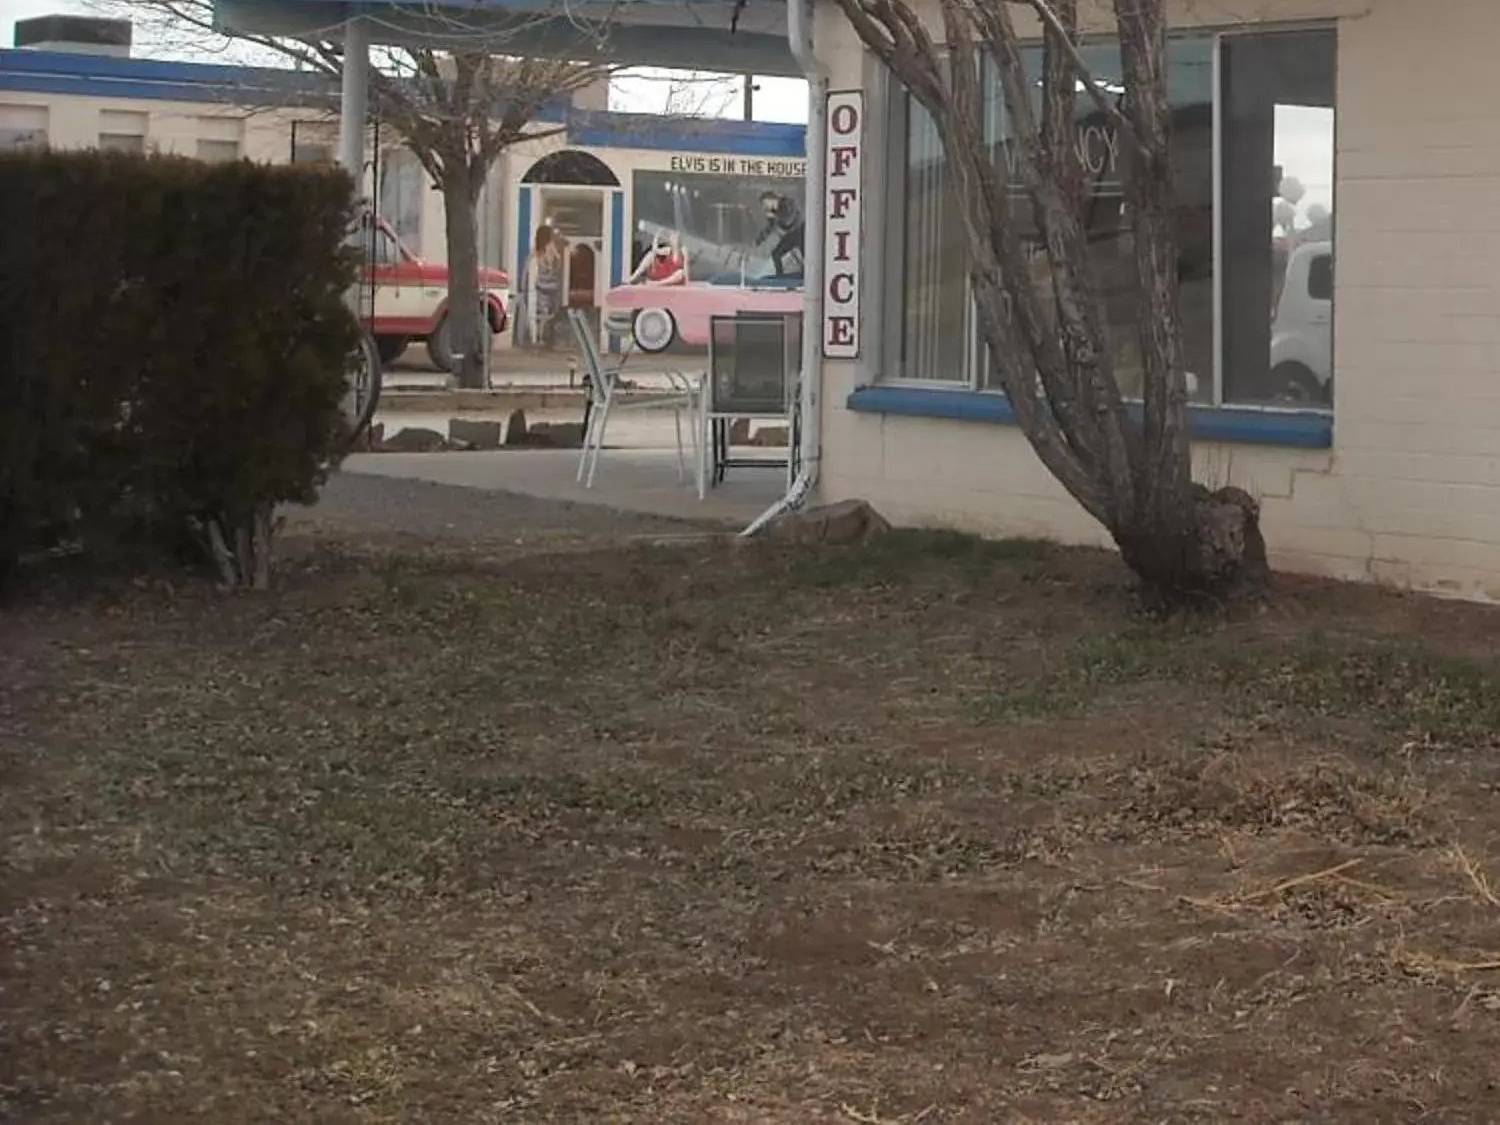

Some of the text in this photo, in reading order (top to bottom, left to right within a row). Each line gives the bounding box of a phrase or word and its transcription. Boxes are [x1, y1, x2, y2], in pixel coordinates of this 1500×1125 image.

[671, 155, 705, 172] ELVIS
[709, 156, 721, 172] IS
[723, 158, 736, 173] IN
[740, 159, 764, 174] THE
[828, 103, 858, 347] OFFICE
